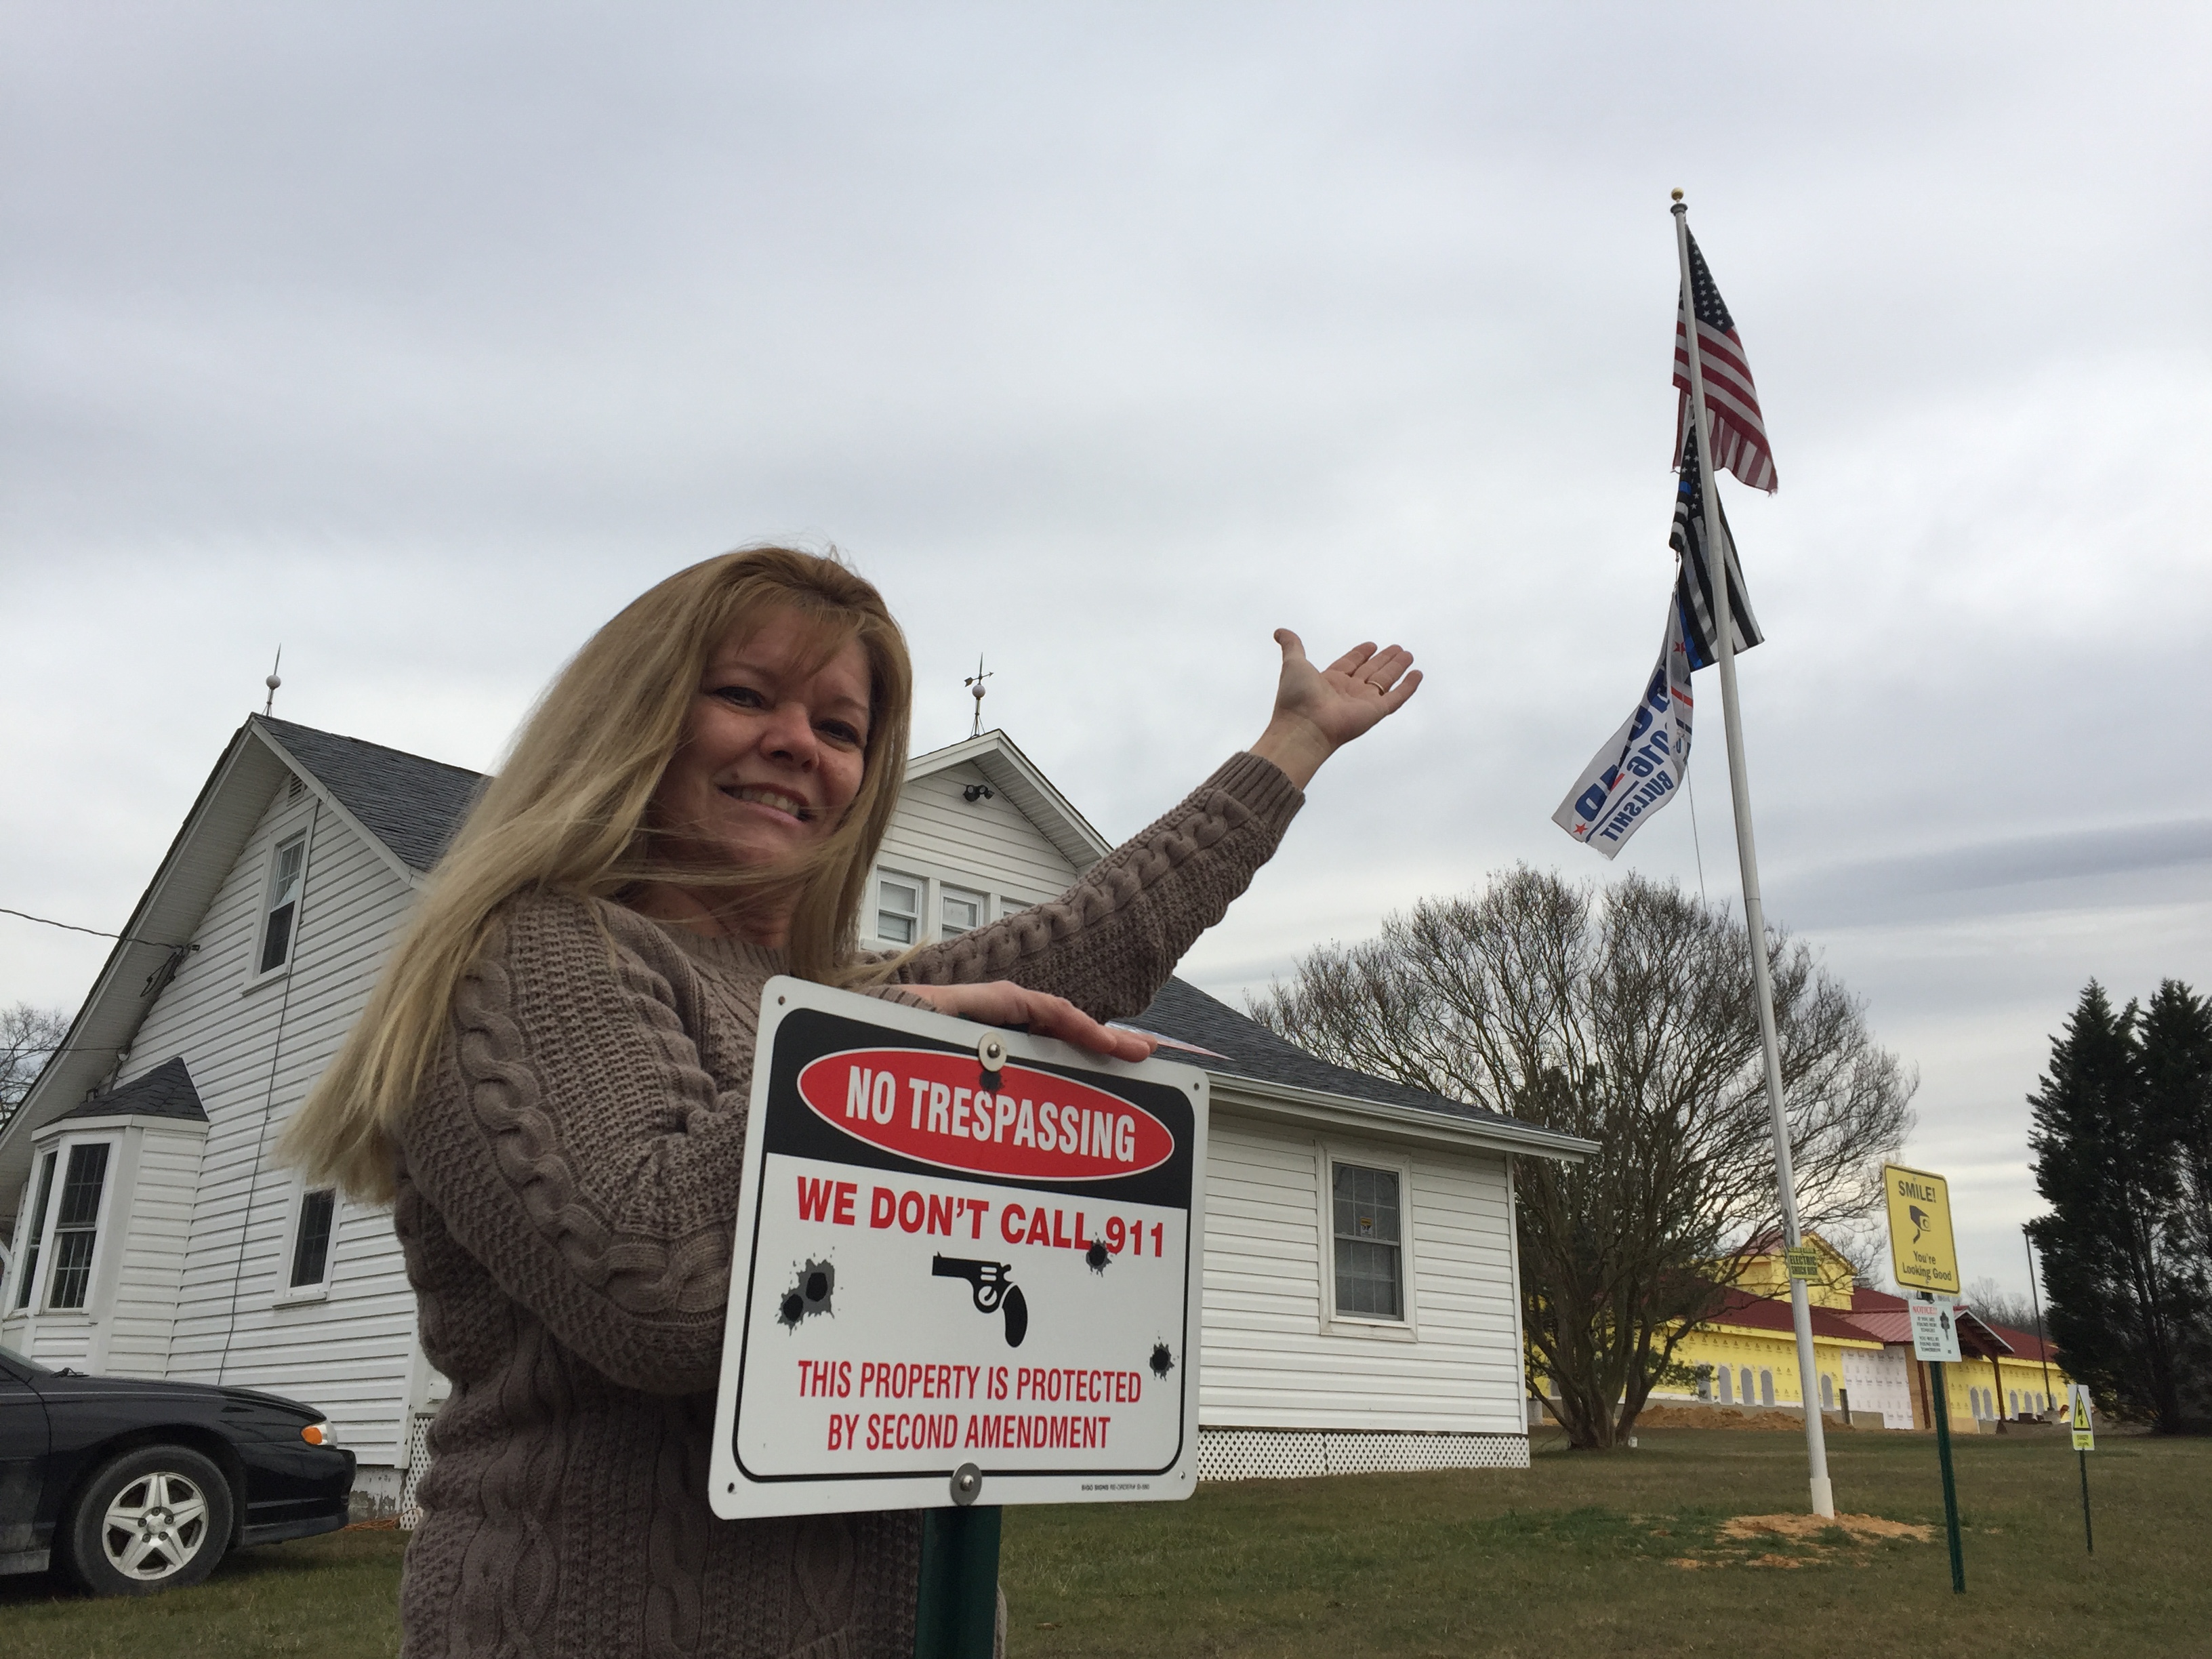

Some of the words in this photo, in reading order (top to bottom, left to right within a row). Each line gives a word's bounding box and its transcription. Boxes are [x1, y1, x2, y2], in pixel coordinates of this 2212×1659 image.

[846, 1065, 896, 1125] NO
[909, 1077, 1135, 1162] TRESPASSING
[1898, 1180, 1936, 1203] SMILE!
[798, 1176, 857, 1226] WE
[869, 1187, 989, 1240] DON'T
[1000, 1204, 1094, 1251] CALL
[1105, 1216, 1164, 1258] 911
[1790, 1255, 1817, 1266] ELECTRIC
[1902, 1262, 1931, 1281] Looking
[1933, 1267, 1952, 1281] Good
[1913, 1250, 1936, 1265] You're
[798, 1360, 852, 1398] THIS
[859, 1362, 981, 1399] PROPERTY
[987, 1366, 1009, 1400] IS
[1017, 1368, 1142, 1403] PROTECTED
[827, 1414, 860, 1451] BY
[865, 1413, 958, 1450] SECOND
[964, 1415, 1111, 1450] AMENDMENT
